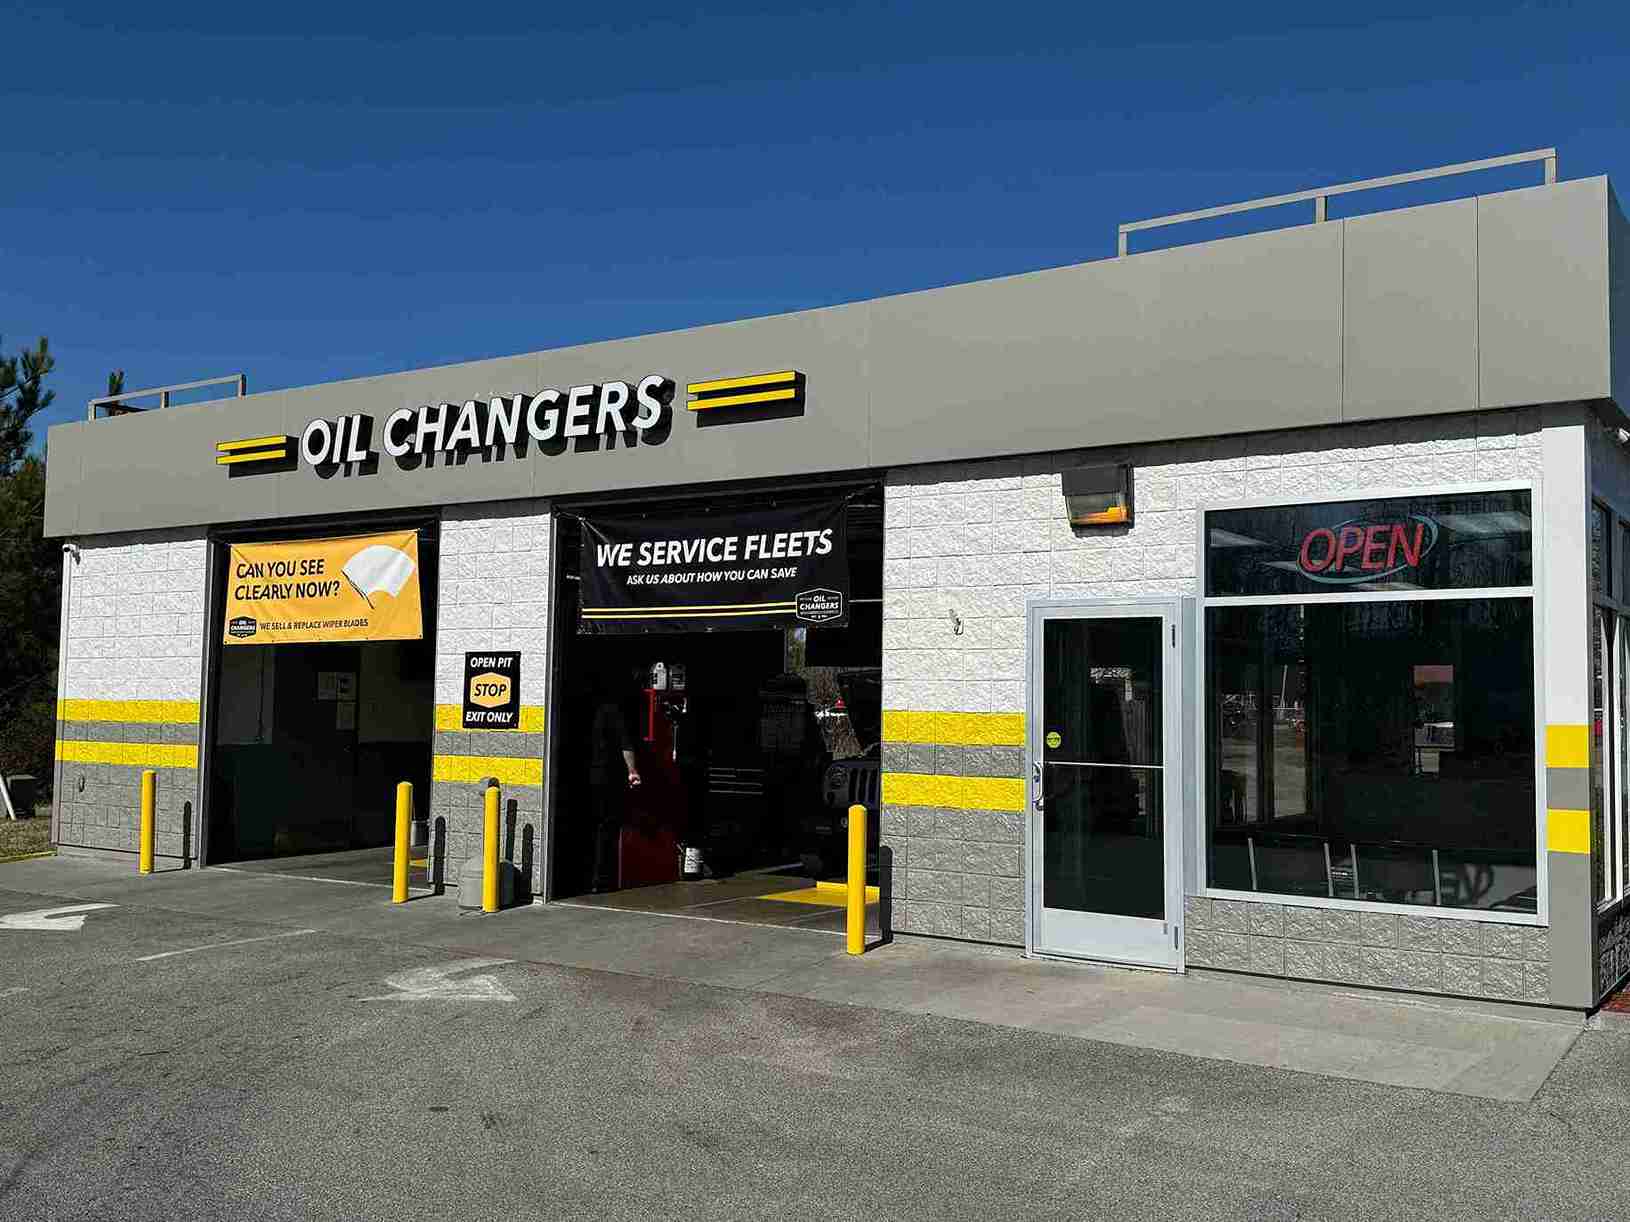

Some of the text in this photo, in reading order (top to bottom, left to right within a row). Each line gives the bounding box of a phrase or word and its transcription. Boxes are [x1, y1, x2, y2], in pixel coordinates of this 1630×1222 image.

[301, 374, 665, 466] OIL CHANGERS
[597, 528, 833, 567] WE SERVICE FLEETS
[1298, 522, 1425, 573] OPEN
[236, 558, 325, 579] CAN YOU SEE
[626, 567, 798, 585] ASK US ABOUT HOW YOU CAN SAVE
[235, 580, 341, 600] CLEARLY NOW?
[260, 622, 270, 630] WE
[322, 620, 343, 629] WIPER
[470, 656, 513, 668] OPEN PIT
[474, 683, 507, 696] STOP
[465, 711, 513, 723] EXIT ONLY
